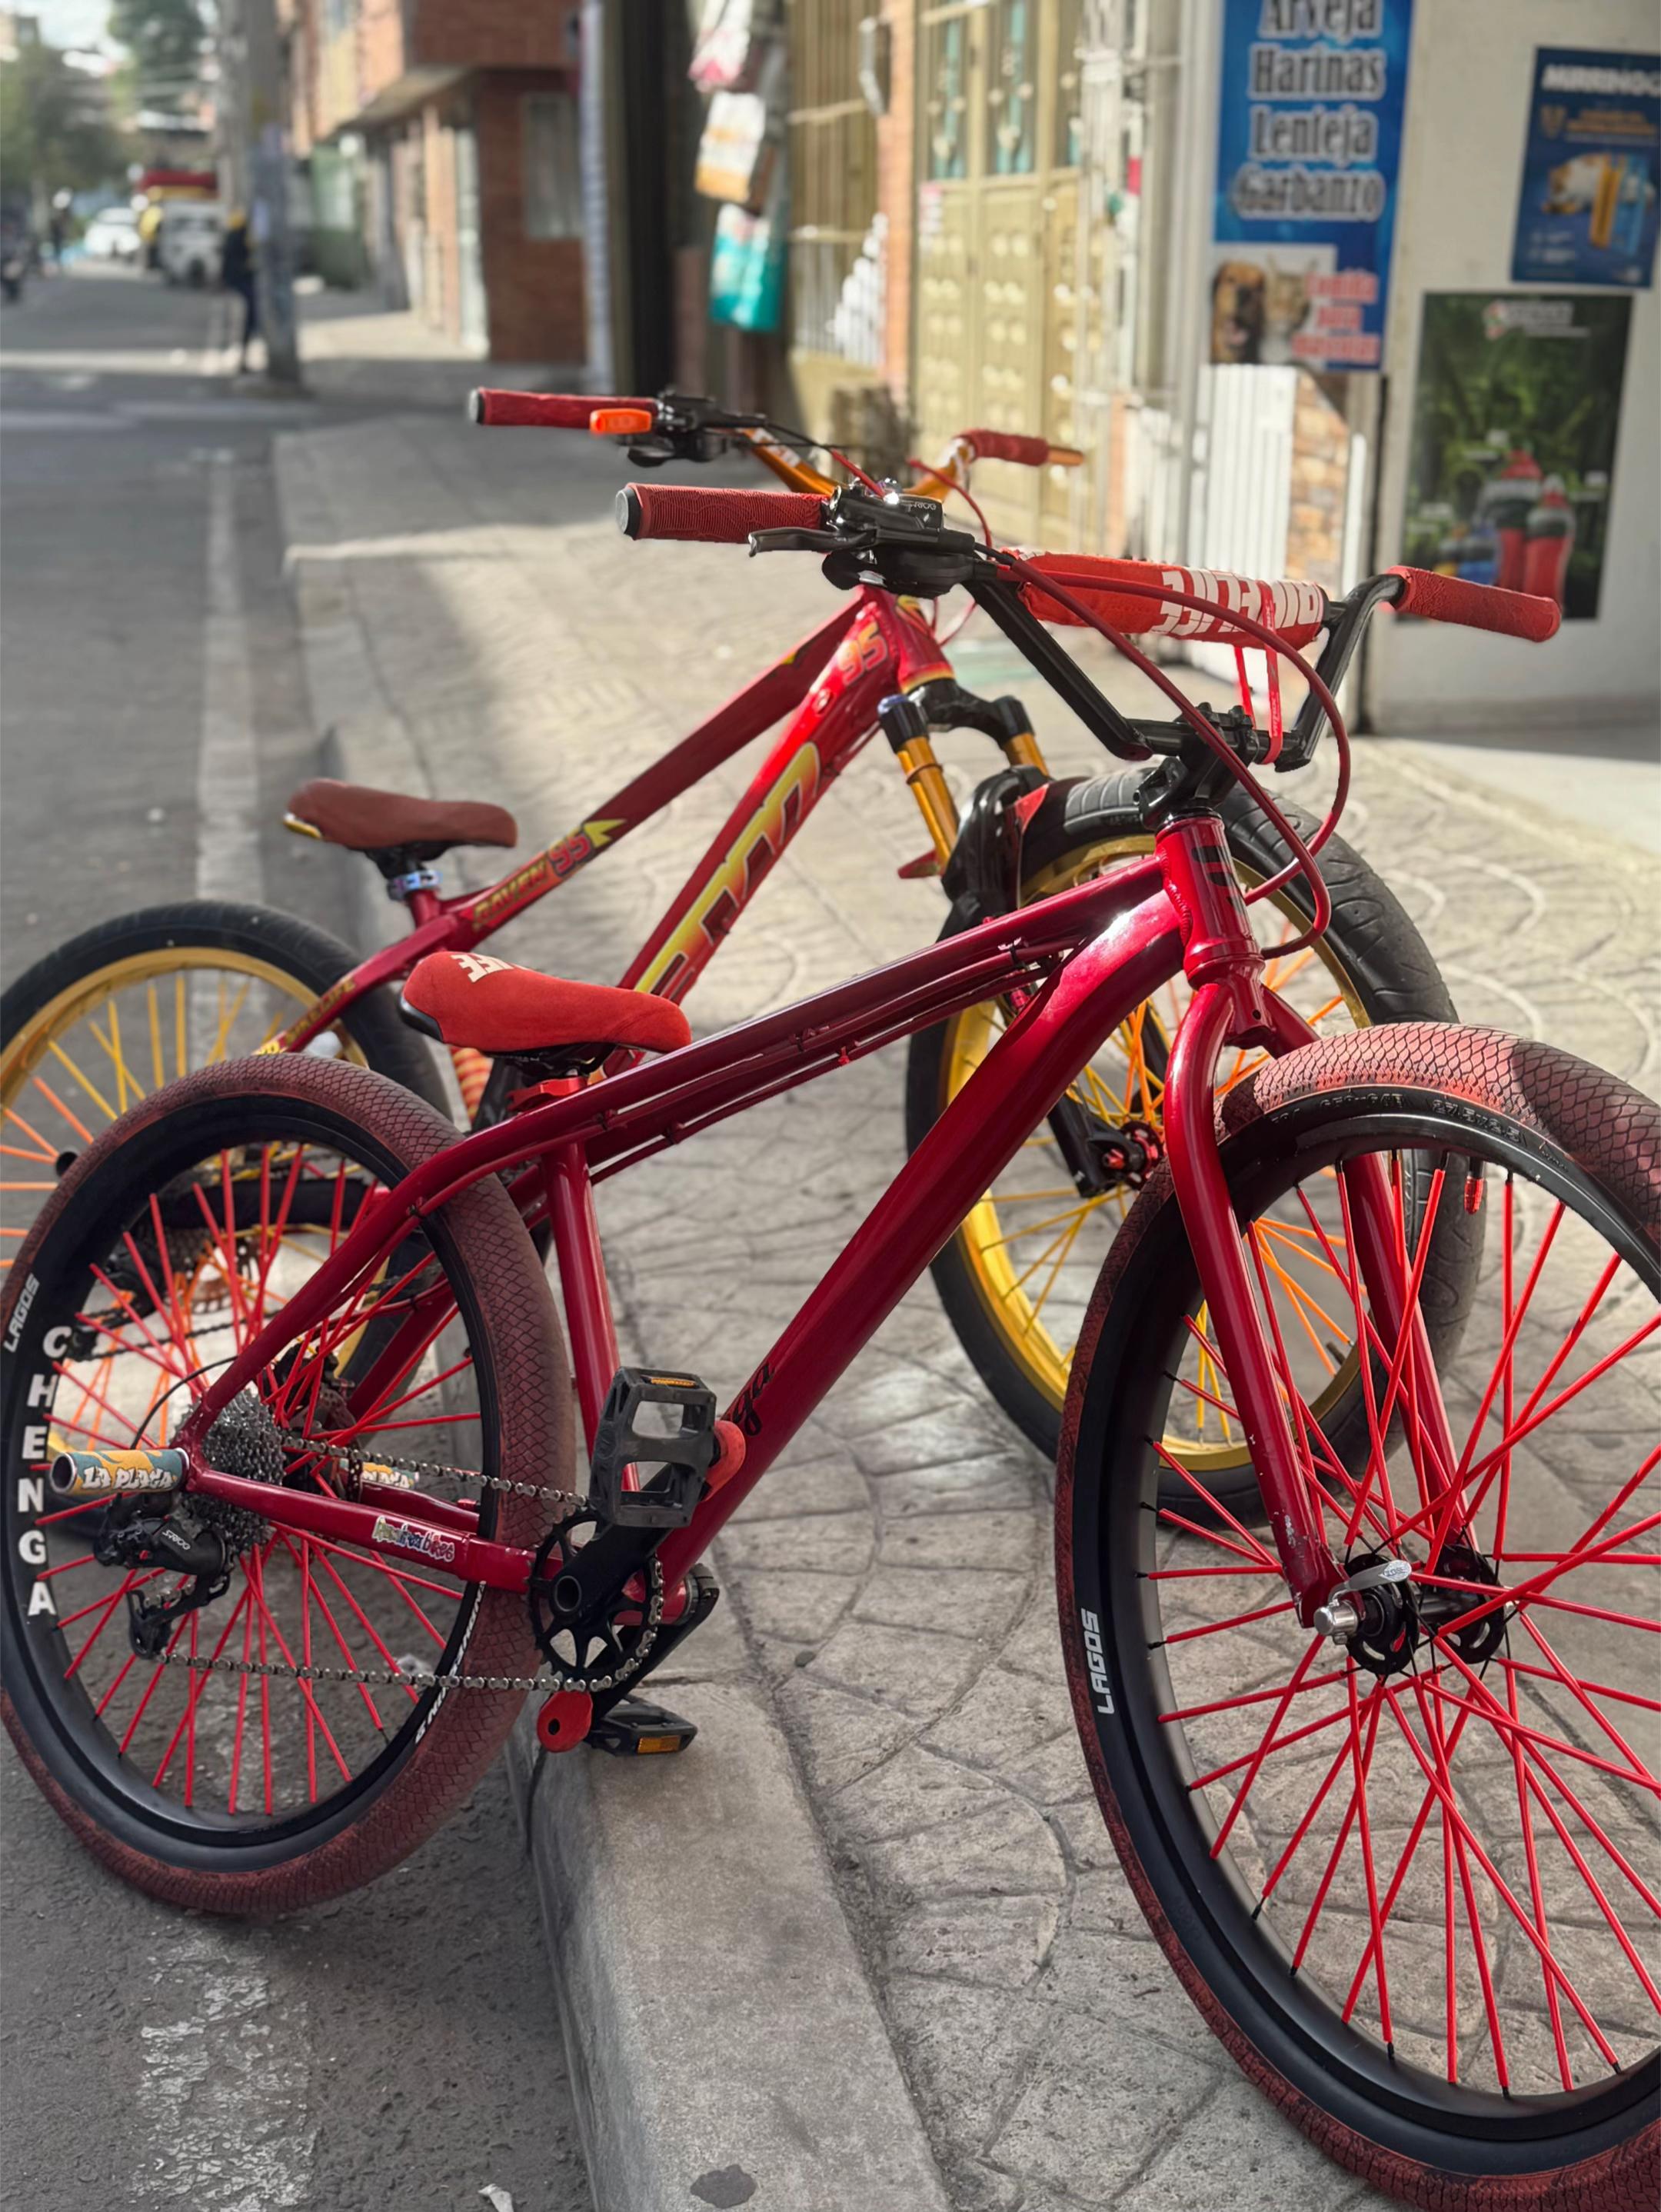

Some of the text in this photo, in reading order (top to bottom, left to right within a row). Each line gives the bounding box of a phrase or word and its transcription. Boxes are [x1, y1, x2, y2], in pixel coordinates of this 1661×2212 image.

[1260, 0, 1384, 43] Arveja
[1250, 45, 1385, 98] Harinas
[1250, 105, 1378, 165] Lenteja
[1234, 165, 1385, 220] Garbanzo
[835, 619, 888, 686] 95
[547, 827, 591, 875] 95
[3, 1273, 40, 1352] LAGOS
[18, 1325, 72, 1617] CHENGA
[82, 1465, 174, 1489] LA PLAYA
[1080, 1607, 1115, 1714] LAGOS
